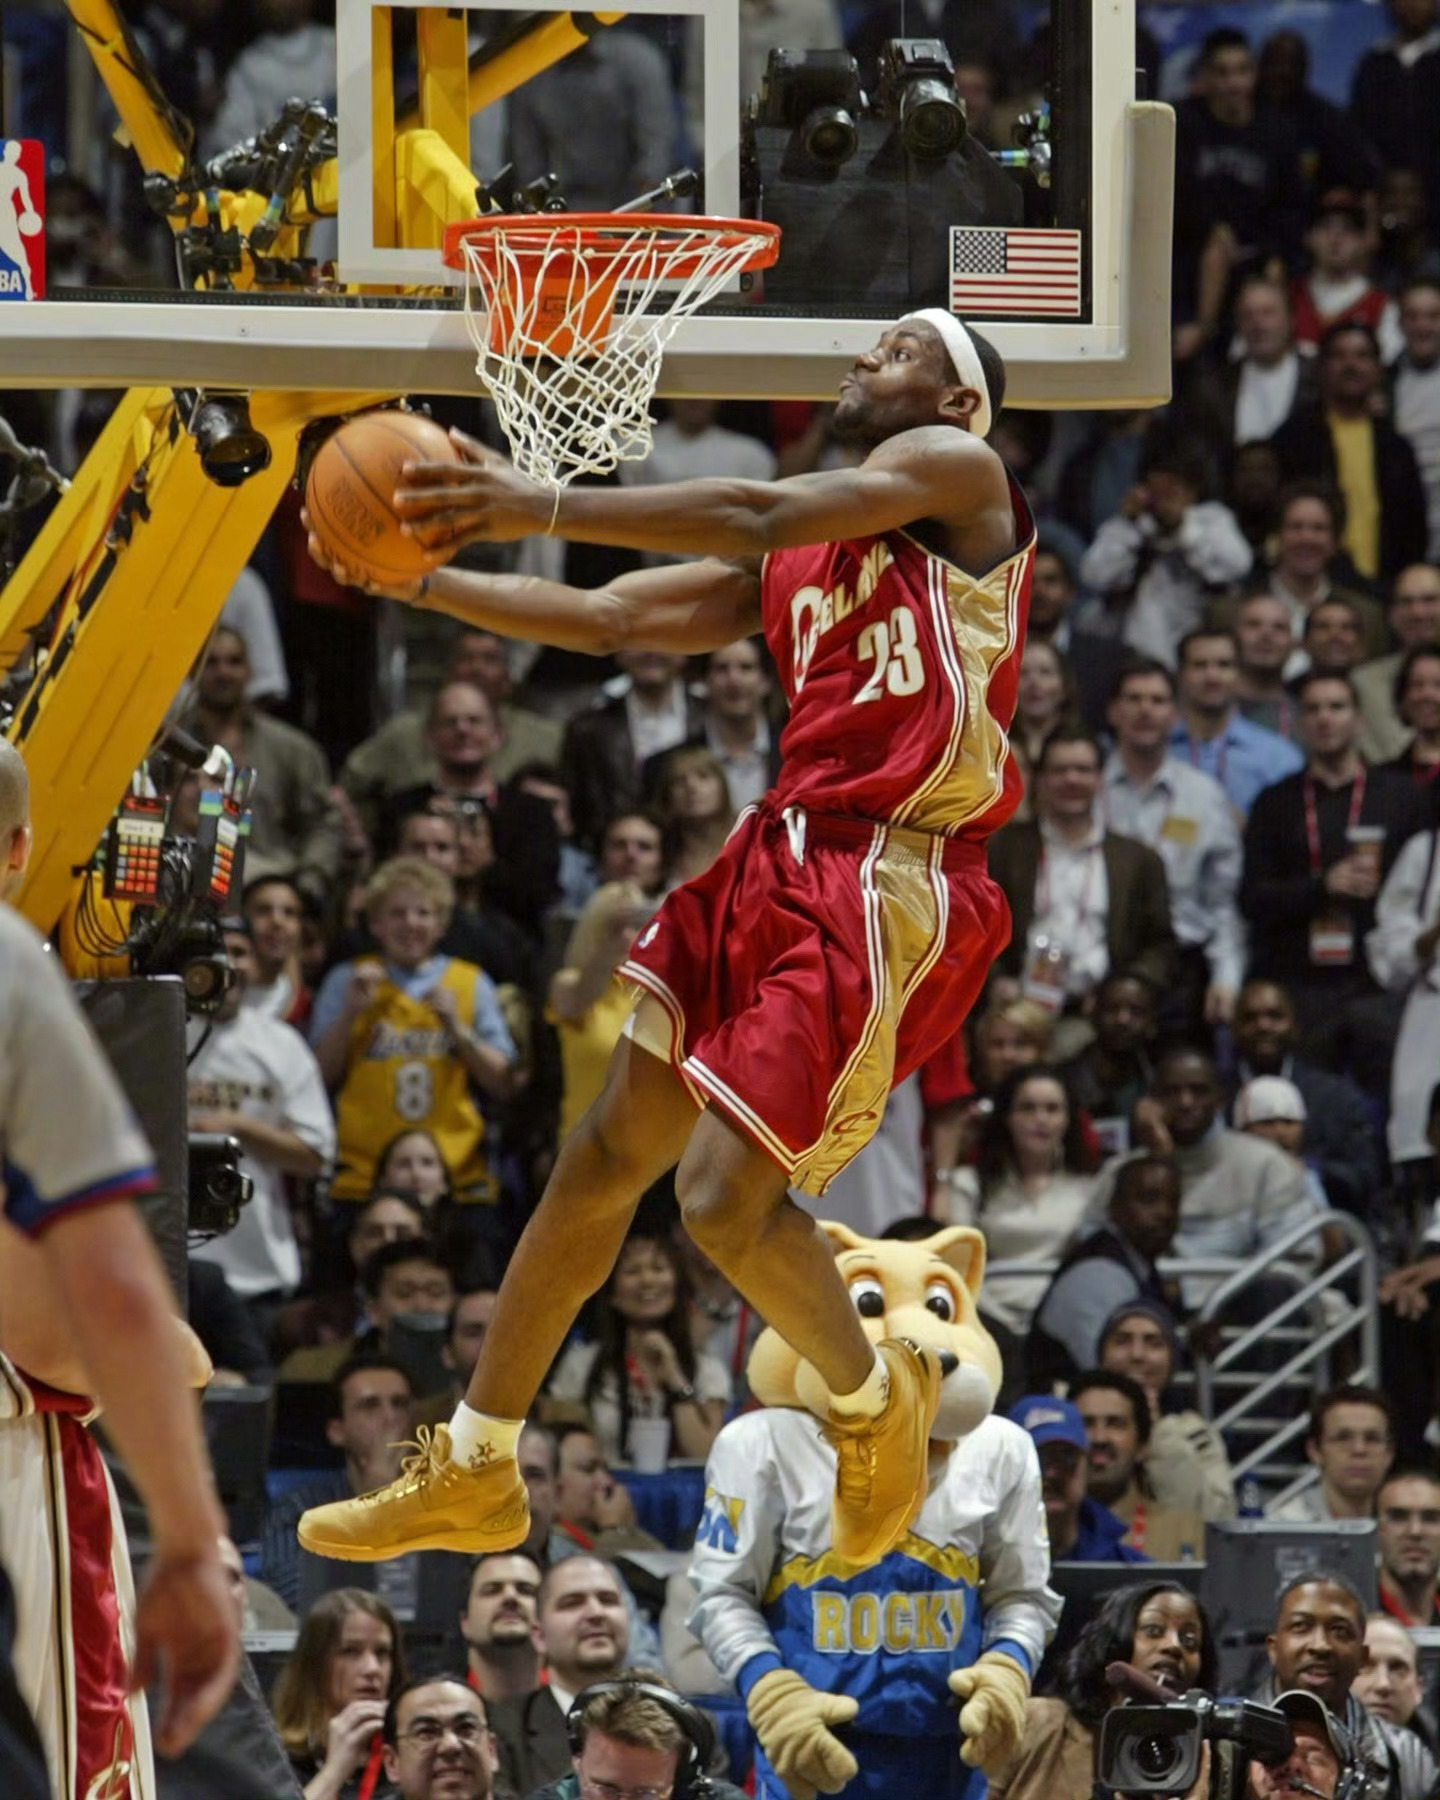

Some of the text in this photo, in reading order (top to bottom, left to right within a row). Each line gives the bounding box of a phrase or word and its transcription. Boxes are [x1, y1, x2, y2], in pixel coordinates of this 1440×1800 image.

[852, 606, 926, 705] 23
[395, 1060, 433, 1122] 8
[811, 1589, 965, 1655] ROCKY
